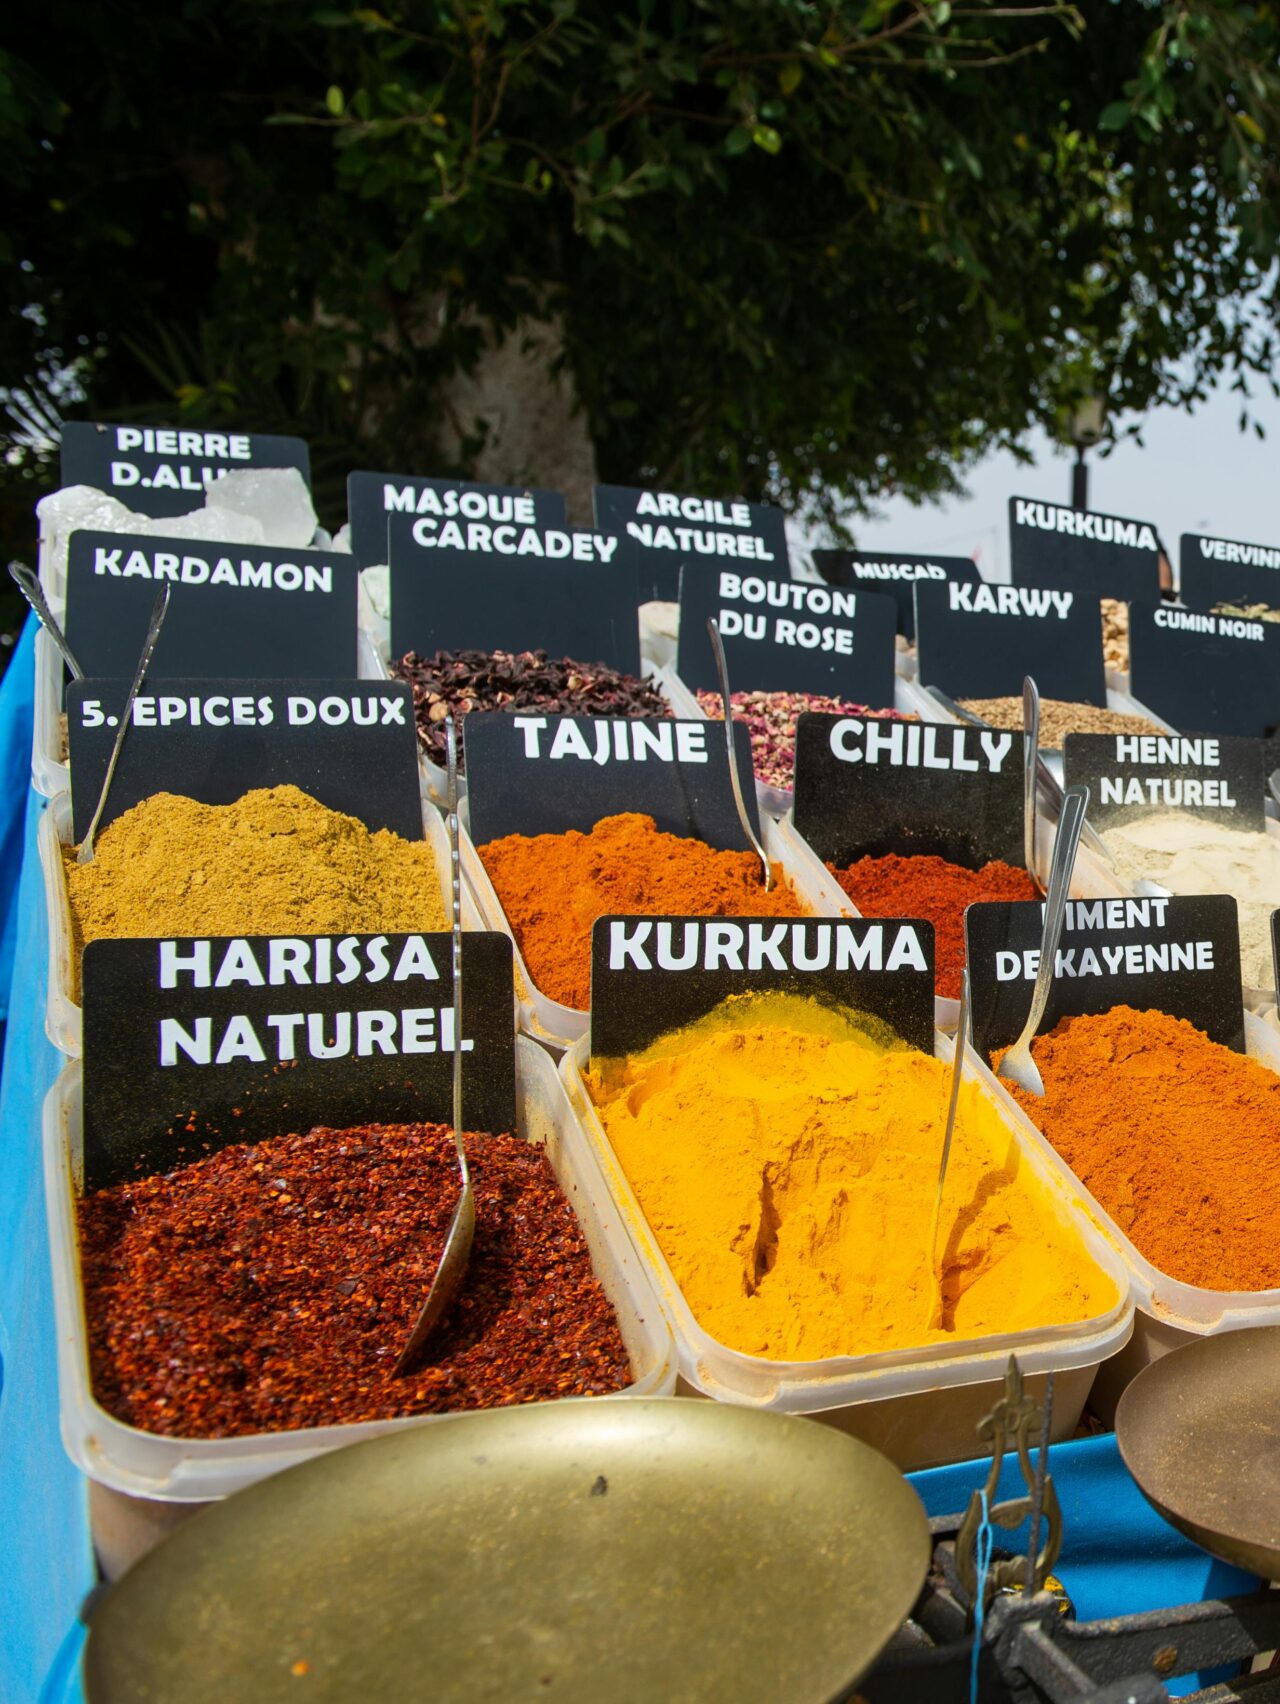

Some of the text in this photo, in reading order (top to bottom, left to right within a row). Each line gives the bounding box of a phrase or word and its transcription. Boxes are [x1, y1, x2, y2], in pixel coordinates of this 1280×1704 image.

[117, 427, 251, 459] PIERRE
[111, 461, 228, 490] D.ALU
[636, 492, 752, 527] ARGILE
[1015, 501, 1158, 551] KURKUMA
[412, 517, 617, 563] CARCADEY
[627, 521, 774, 561] NATUREL
[95, 549, 333, 592] KARDAMON
[852, 562, 947, 580] MUSCAD
[719, 572, 856, 618] BOUTON
[948, 582, 1074, 619] KARWY
[719, 609, 854, 655] DU ROSE
[1154, 609, 1264, 642] CUMIN NOIR
[82, 695, 406, 727] 5. EPICES DOUX
[514, 717, 709, 766] TAJINE
[829, 719, 1013, 773] CHILLY
[1116, 735, 1220, 766] HENNE
[1100, 776, 1237, 807] NATUREL
[1041, 899, 1169, 930] IMENT
[159, 935, 440, 989] HARISSA
[608, 921, 929, 971] KURKUMA
[995, 941, 1214, 981] DE KAYENNE
[159, 1007, 474, 1067] NATUREL
